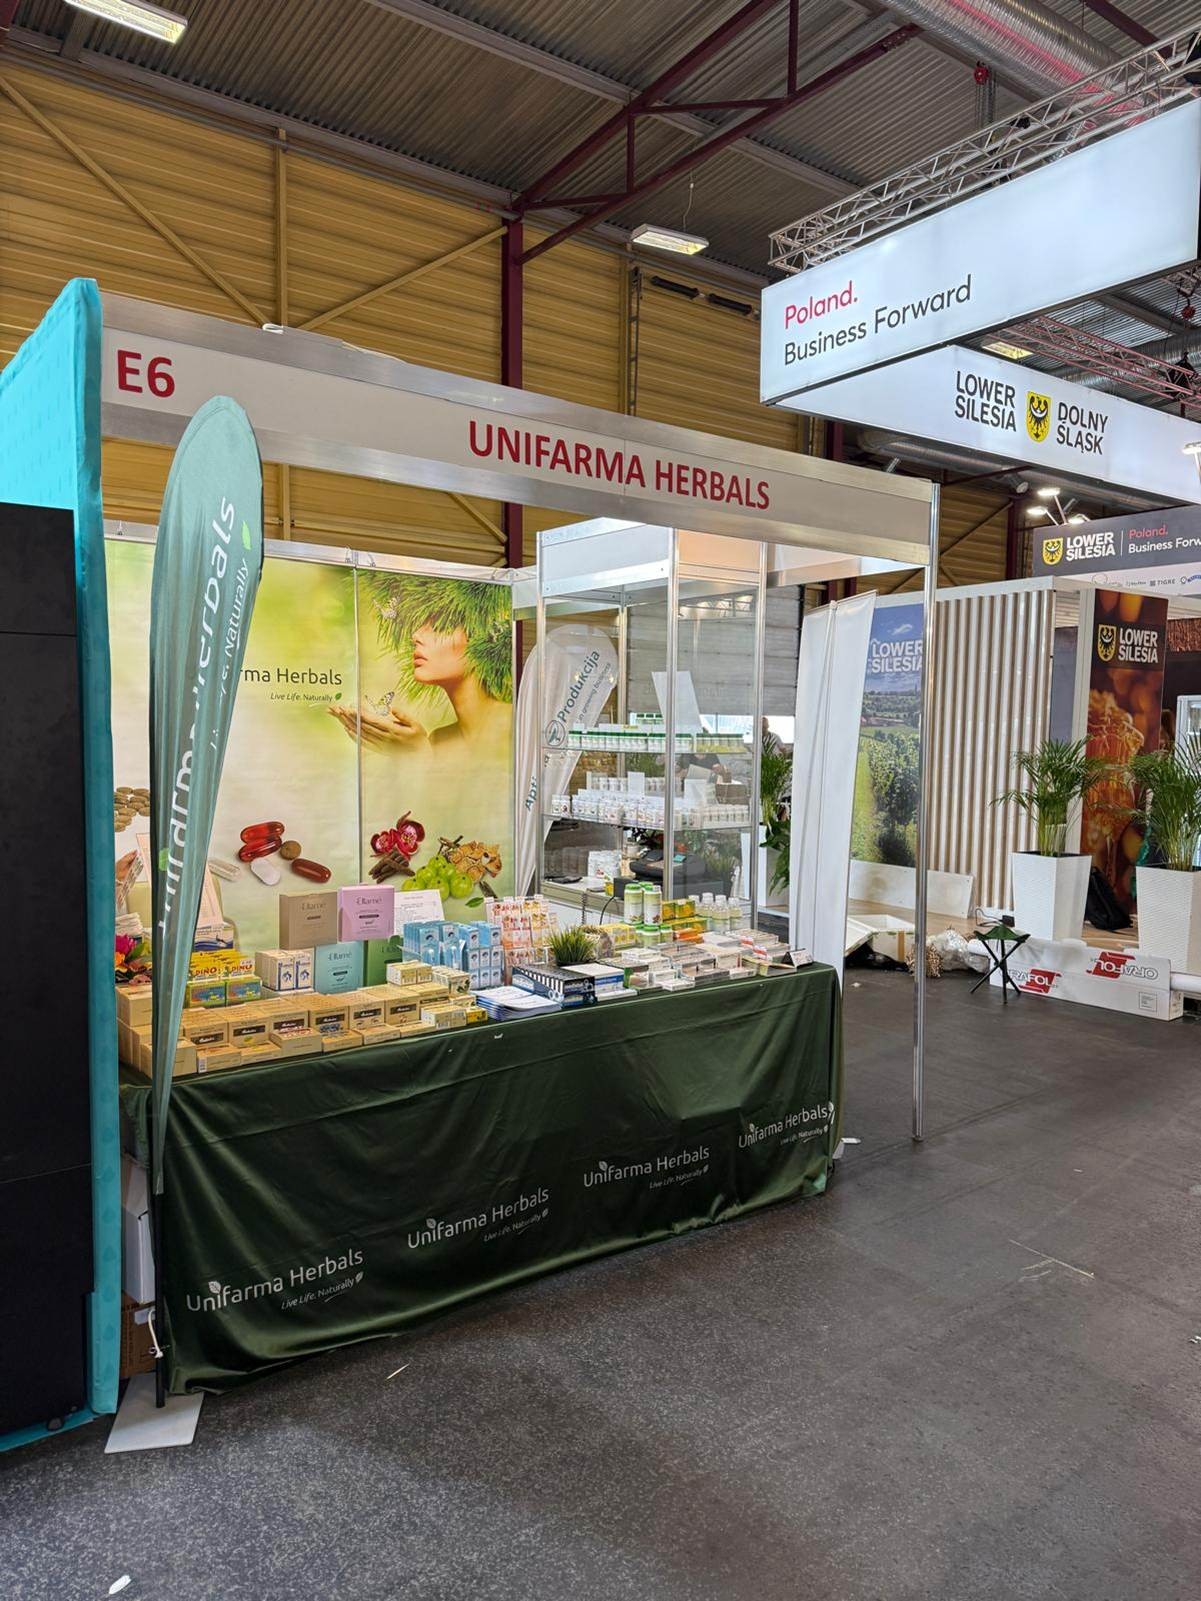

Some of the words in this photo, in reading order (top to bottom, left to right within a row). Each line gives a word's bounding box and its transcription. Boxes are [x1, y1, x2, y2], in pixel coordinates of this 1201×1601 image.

[784, 280, 859, 330] Poland.
[784, 319, 867, 366] Business
[874, 273, 972, 334] Forward
[116, 350, 176, 398] E6
[956, 370, 1016, 408] LOWER
[954, 398, 1017, 433] SILESIA
[1057, 401, 1109, 434] DOLNY
[1056, 417, 1103, 455] ŚLĄSK
[469, 420, 646, 488] UNIFARMA
[654, 460, 770, 510] HERBALS
[1066, 532, 1114, 549] LOWER
[1128, 525, 1168, 540] Poland.
[1128, 542, 1173, 554] Business
[1066, 544, 1116, 562] SILESIA
[224, 557, 248, 658] Naturally
[872, 640, 923, 658] LOWER
[1118, 645, 1159, 664] SILESIA
[1119, 627, 1158, 647] LOWER
[277, 667, 343, 685] Herbals
[557, 651, 600, 722] Produkcija
[270, 691, 285, 700] Live
[303, 693, 333, 702] Naturally
[1006, 968, 1054, 987] RAFOL
[738, 1121, 783, 1148] Unifarma
[784, 1104, 828, 1129] Herbals
[583, 1162, 652, 1188] Unifarma
[657, 1145, 710, 1172] Herbals
[407, 1215, 487, 1249] Unifarma
[492, 1187, 549, 1222] Herbals
[186, 1278, 284, 1312] Unifarma
[290, 1248, 364, 1287] Herbals
[281, 1298, 298, 1310] Live
[317, 1277, 354, 1295] Naturally
